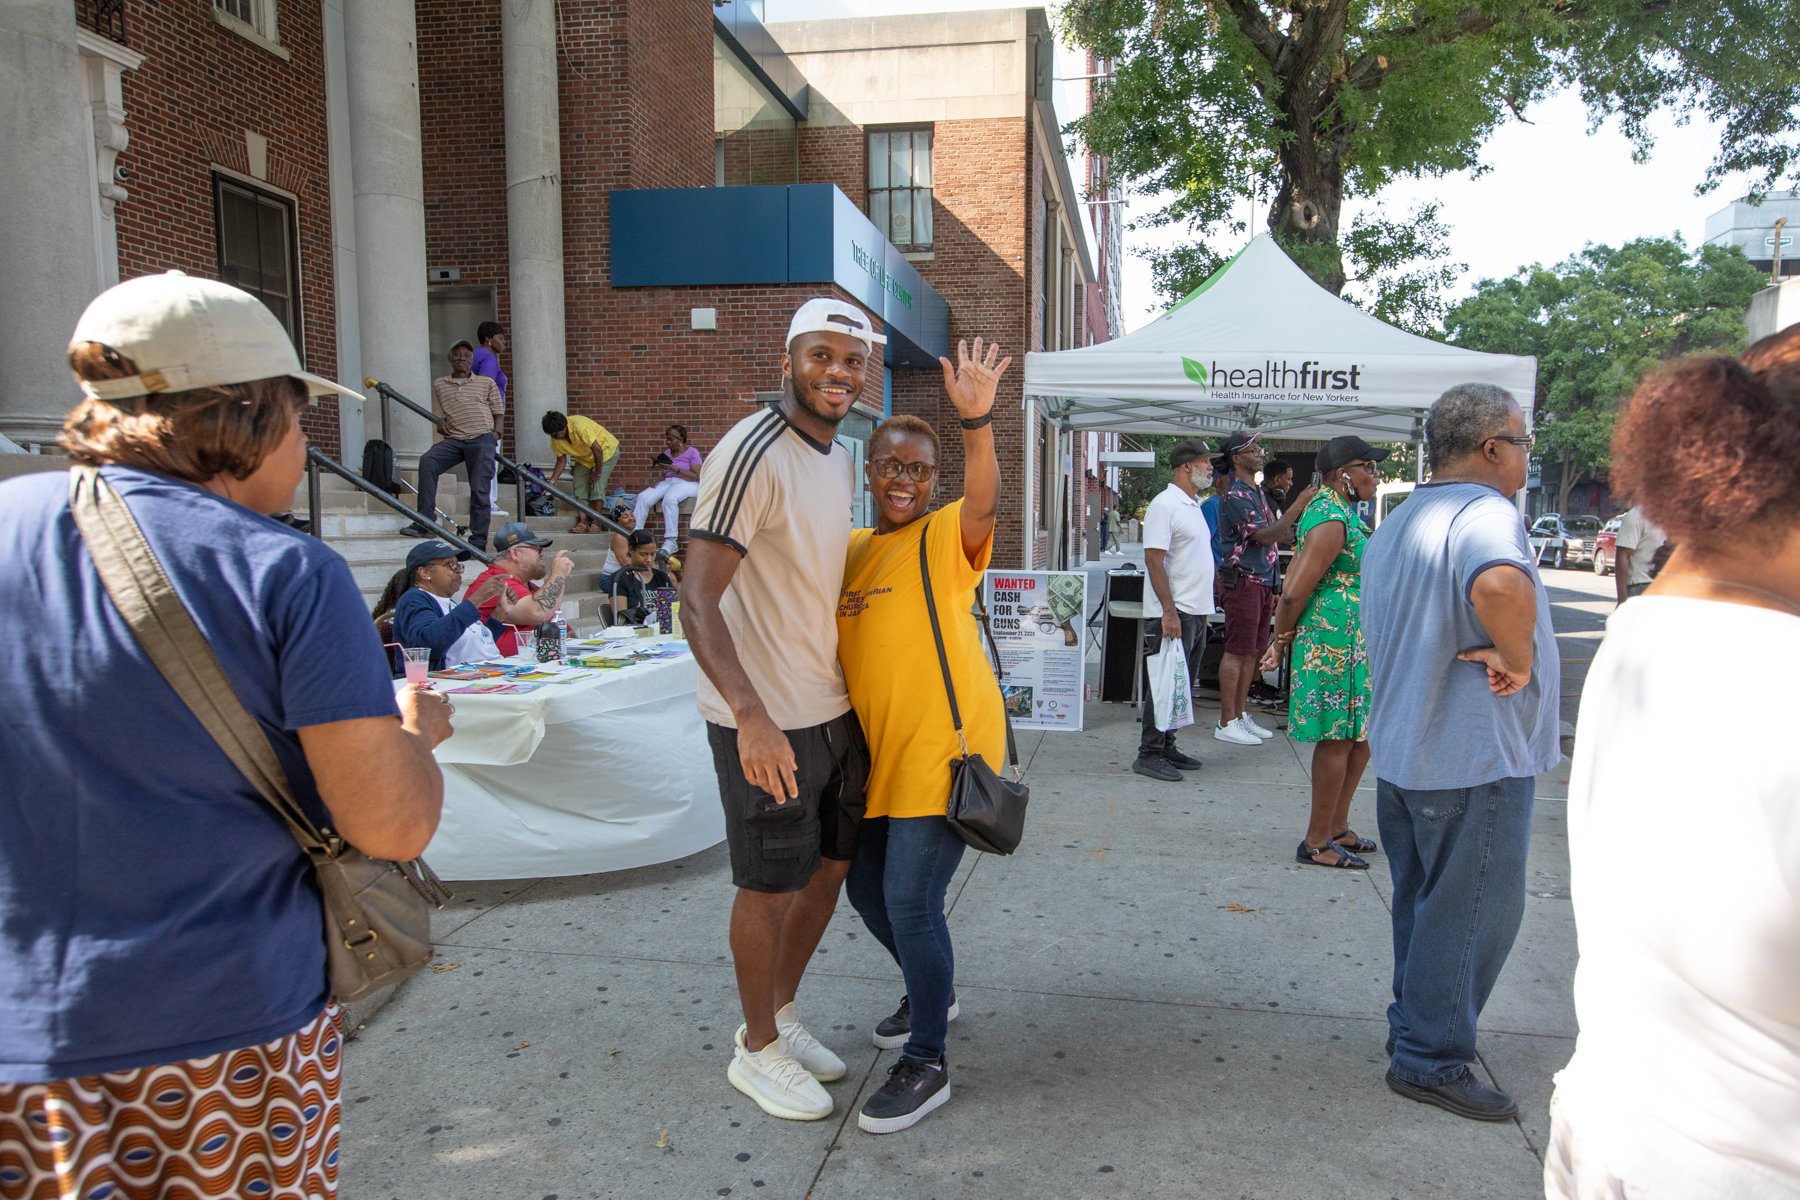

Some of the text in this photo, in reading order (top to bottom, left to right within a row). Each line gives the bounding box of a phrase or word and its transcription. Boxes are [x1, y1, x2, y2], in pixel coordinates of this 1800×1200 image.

[1211, 360, 1361, 390] healthfirst
[1211, 390, 1359, 403] Health Insurance for New Yorkers
[994, 578, 1036, 590] WANTED
[994, 591, 1021, 603] CASH
[993, 604, 1012, 616] FOR
[993, 618, 1021, 630] GUNS
